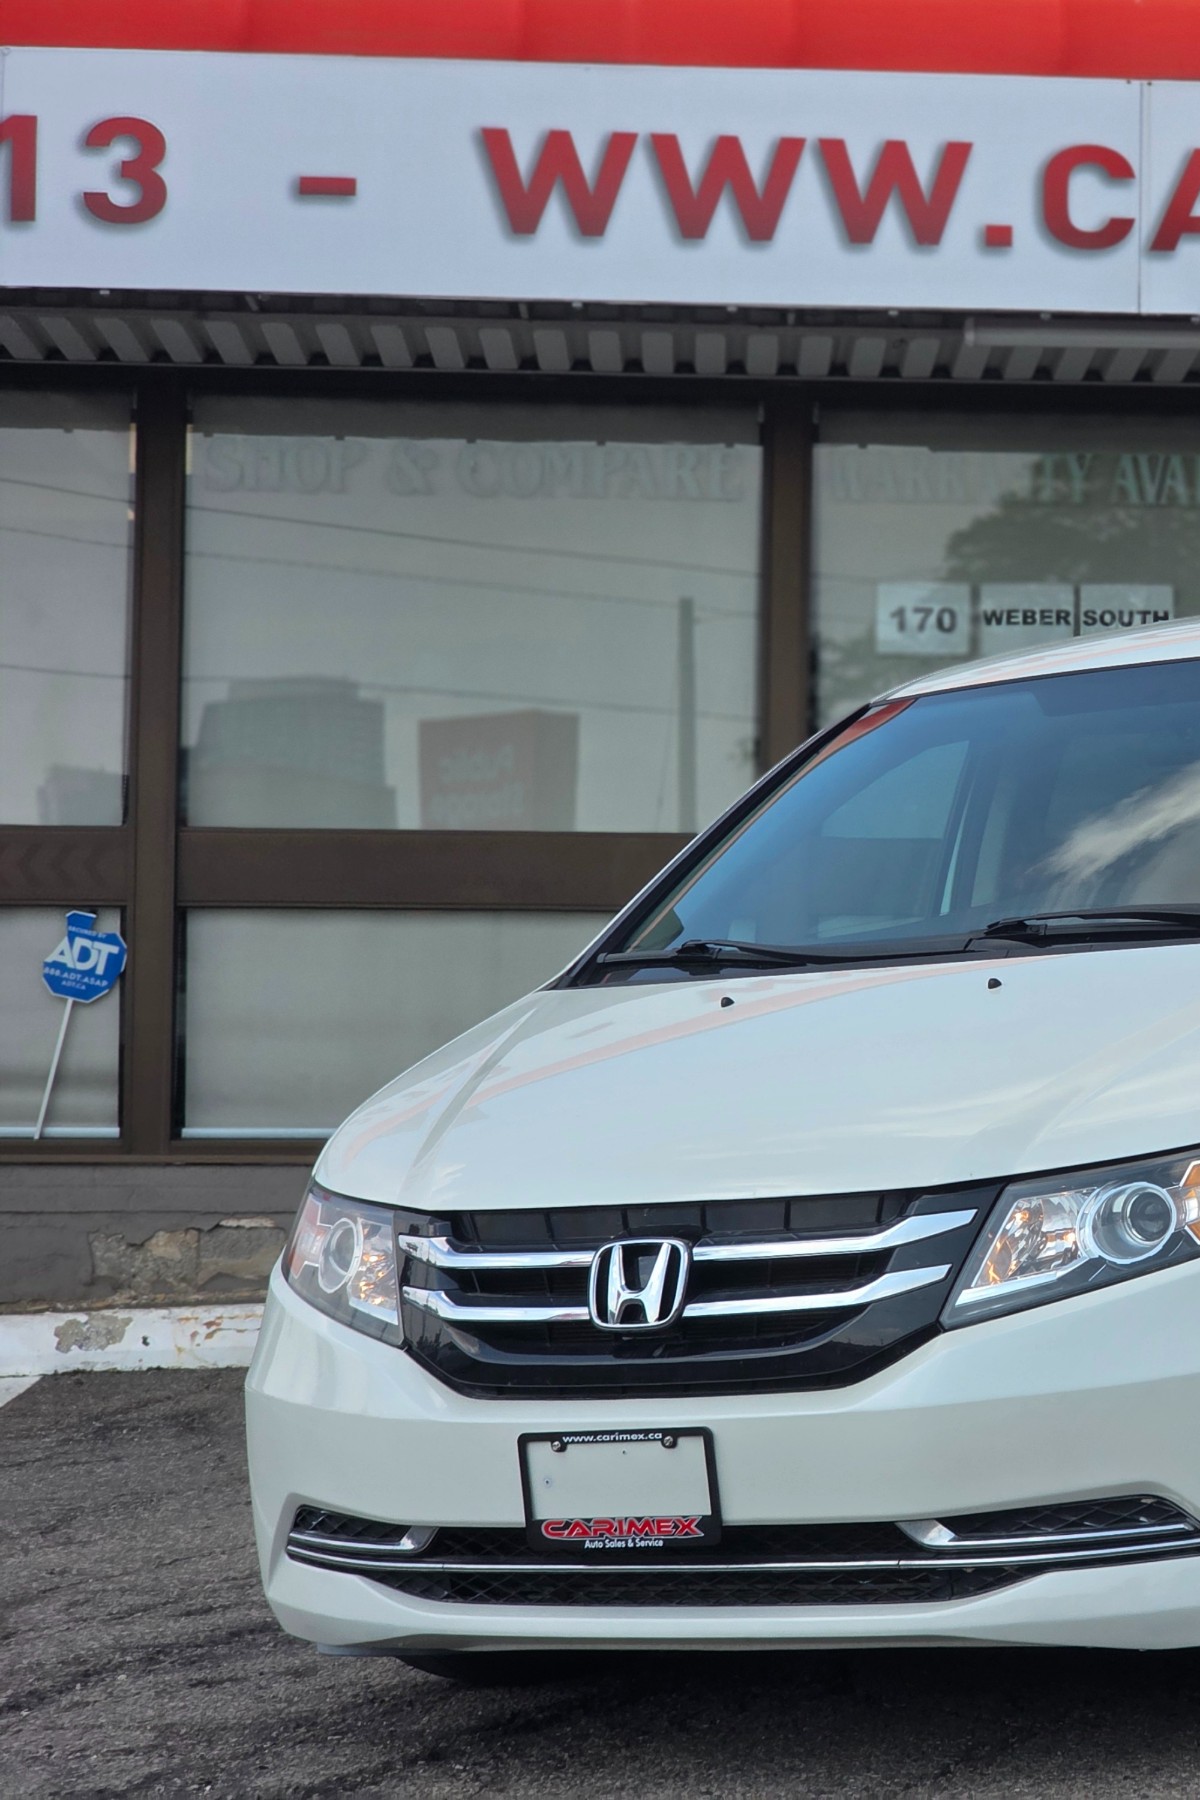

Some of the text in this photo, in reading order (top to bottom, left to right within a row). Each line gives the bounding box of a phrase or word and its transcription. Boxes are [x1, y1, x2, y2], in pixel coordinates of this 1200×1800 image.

[0, 114, 168, 225] 13
[204, 437, 368, 495] SHOP
[457, 442, 747, 502] COMPARE
[833, 449, 1092, 505] WARRTY
[890, 606, 1170, 634] 170 WEBER SOUTH
[43, 936, 120, 976] ADT
[562, 1432, 663, 1444] www.carimex.ca
[542, 1516, 703, 1538] CARIMEX
[584, 1538, 664, 1549] Auto Sales & Service
